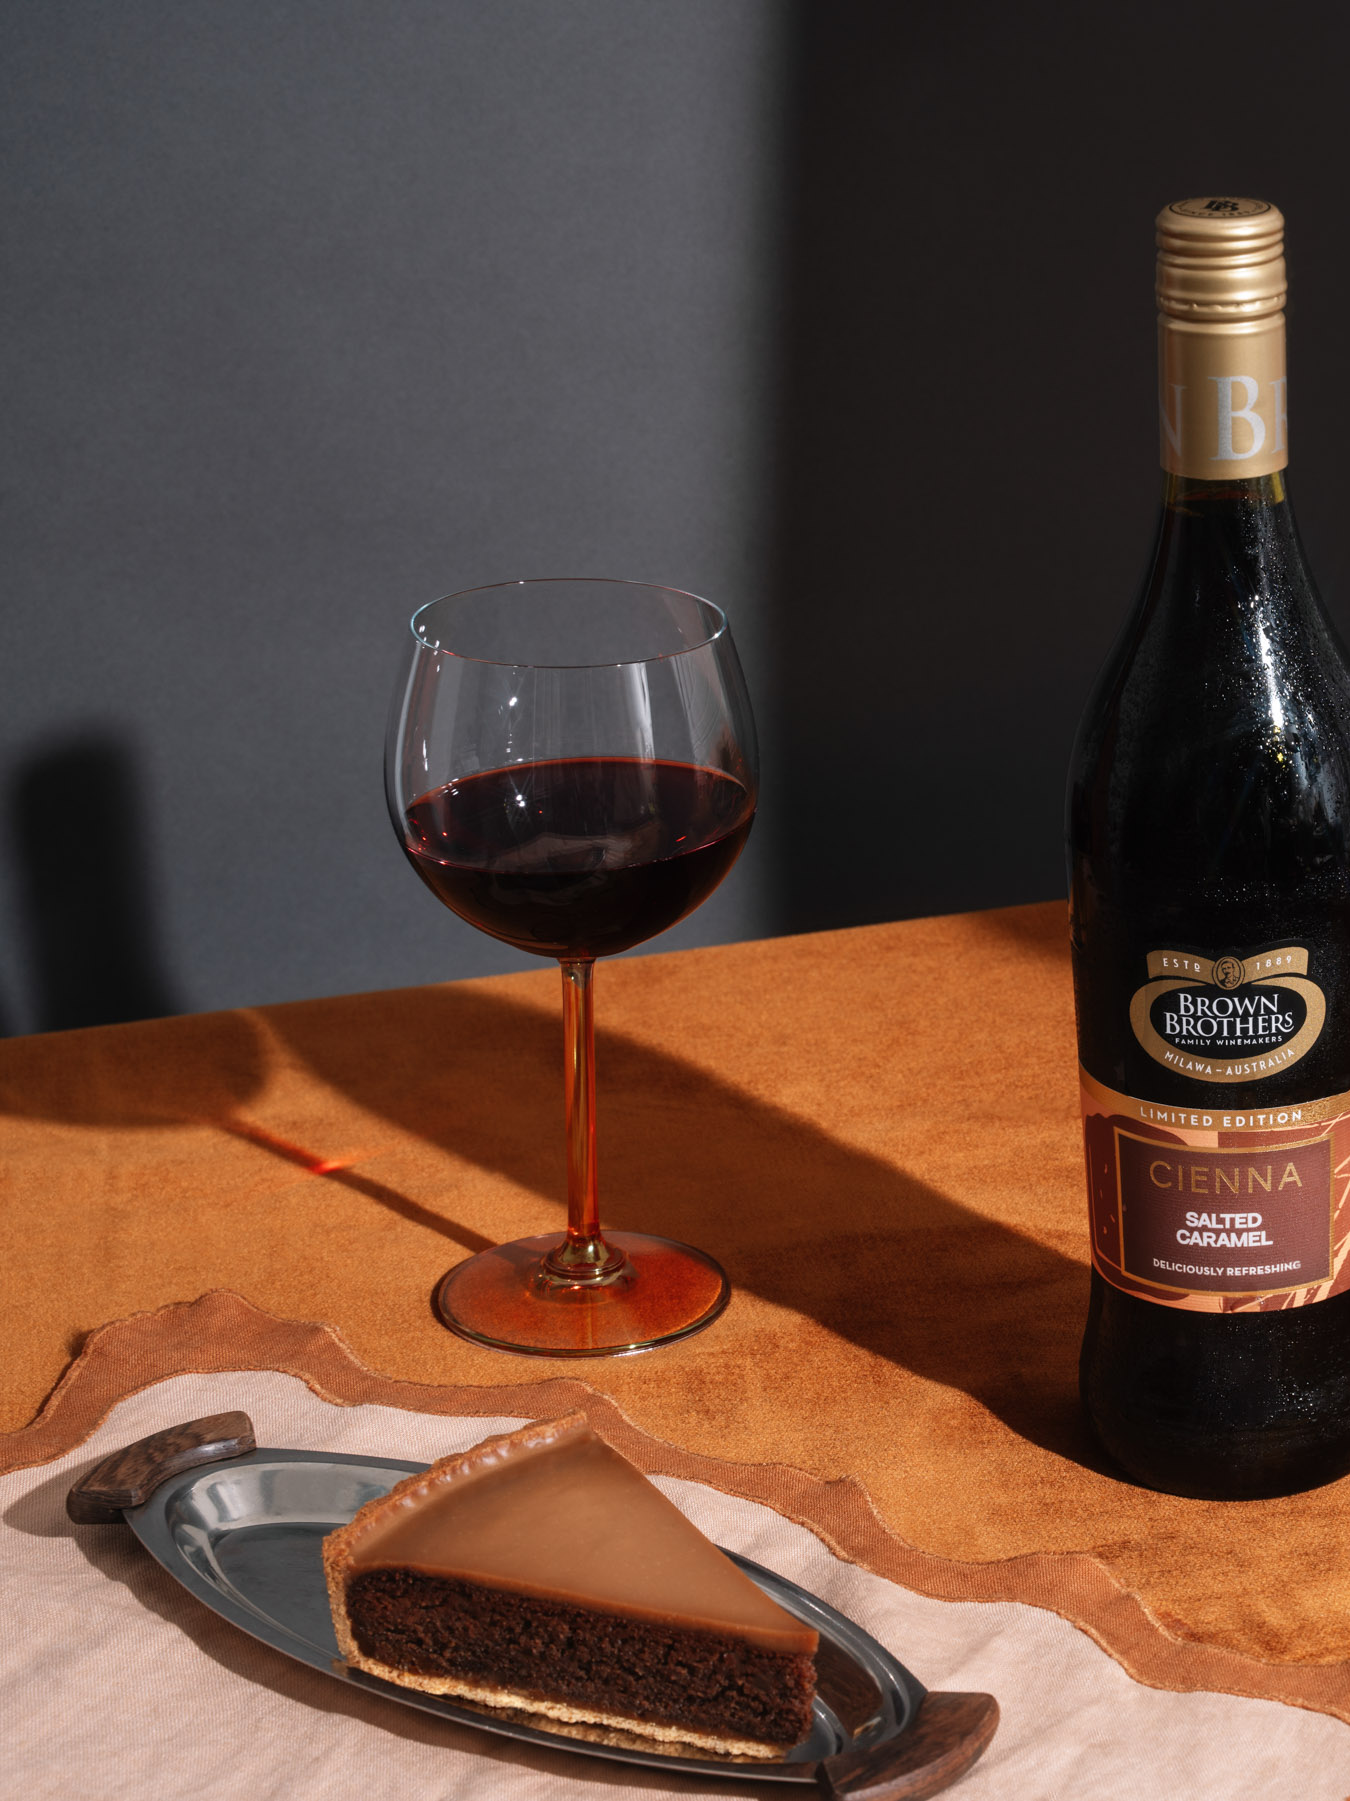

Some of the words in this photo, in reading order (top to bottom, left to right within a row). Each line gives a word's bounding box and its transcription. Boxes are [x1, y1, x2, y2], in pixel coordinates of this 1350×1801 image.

[1256, 955, 1292, 970] 1889
[1178, 993, 1279, 1017] BROWN
[1163, 1011, 1294, 1037] BROTHERS
[1175, 1037, 1211, 1045] FAMILY
[1216, 1035, 1282, 1046] WINEMAKERS
[1164, 1051, 1212, 1075] MILAWA
[1225, 1048, 1295, 1076] AUSTRALIA
[1140, 1106, 1212, 1126] LIMITED
[1223, 1109, 1303, 1127] EDITION
[1149, 1160, 1303, 1194] CIENNA
[1185, 1211, 1262, 1229] SALTED
[1176, 1229, 1273, 1247] CARAMEL
[1153, 1258, 1224, 1276] DELICIOUSLY
[1226, 1260, 1301, 1276] REFRESHING
